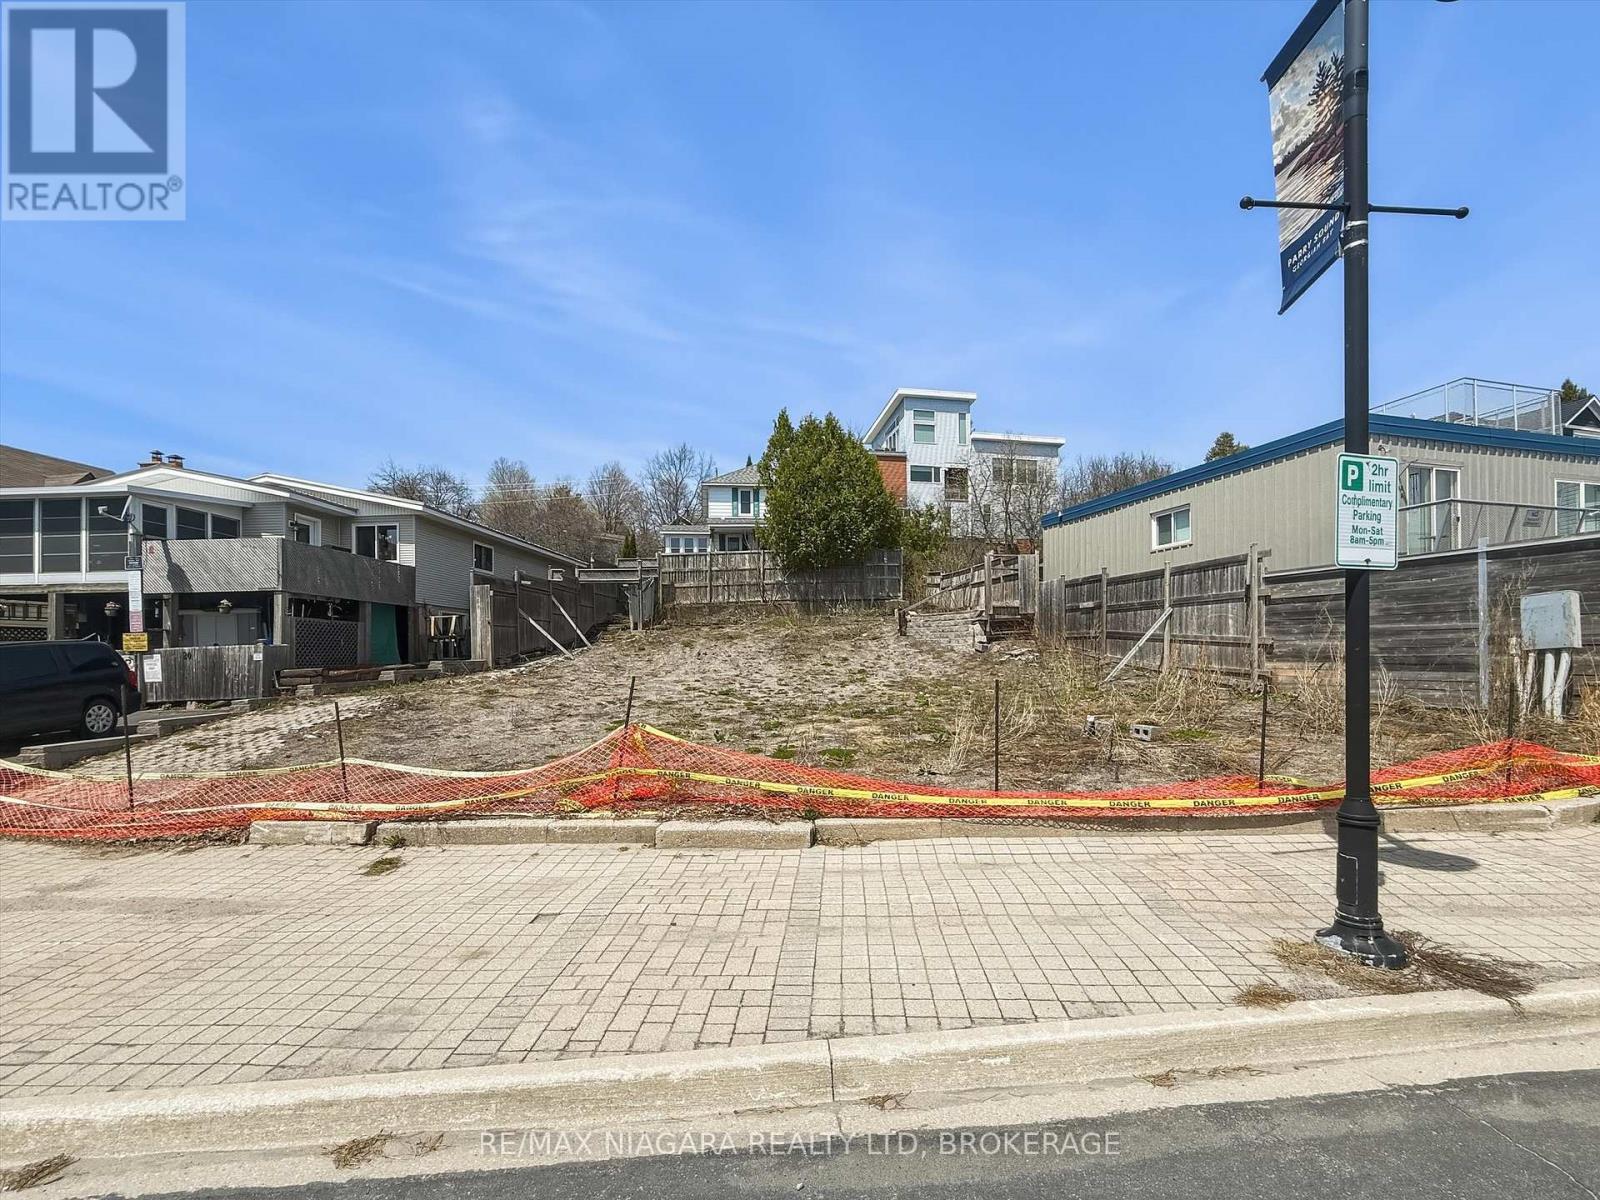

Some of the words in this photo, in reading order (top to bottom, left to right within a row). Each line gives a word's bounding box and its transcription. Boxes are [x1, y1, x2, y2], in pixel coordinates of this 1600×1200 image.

[1288, 239, 1312, 268] PARRY
[1313, 211, 1340, 243] SOUND
[1347, 464, 1359, 487] P
[1371, 463, 1389, 477] 2hr
[1368, 480, 1392, 493] limit
[1342, 494, 1393, 510] Complimentary
[1353, 509, 1382, 524] Parking
[1351, 525, 1384, 536] Mon-Sat
[1349, 535, 1385, 547] 8am-5pm
[656, 770, 691, 779] DANGER
[725, 778, 761, 789] DANGER
[797, 786, 834, 796] DANGER
[871, 792, 910, 801] DANGER
[948, 797, 988, 805] DANGER
[1109, 800, 1151, 808] DANGER
[1193, 799, 1236, 808] DANGER
[1277, 792, 1320, 804] DANGER
[1370, 782, 1403, 793] ANGER
[1441, 770, 1480, 783] DANGER
